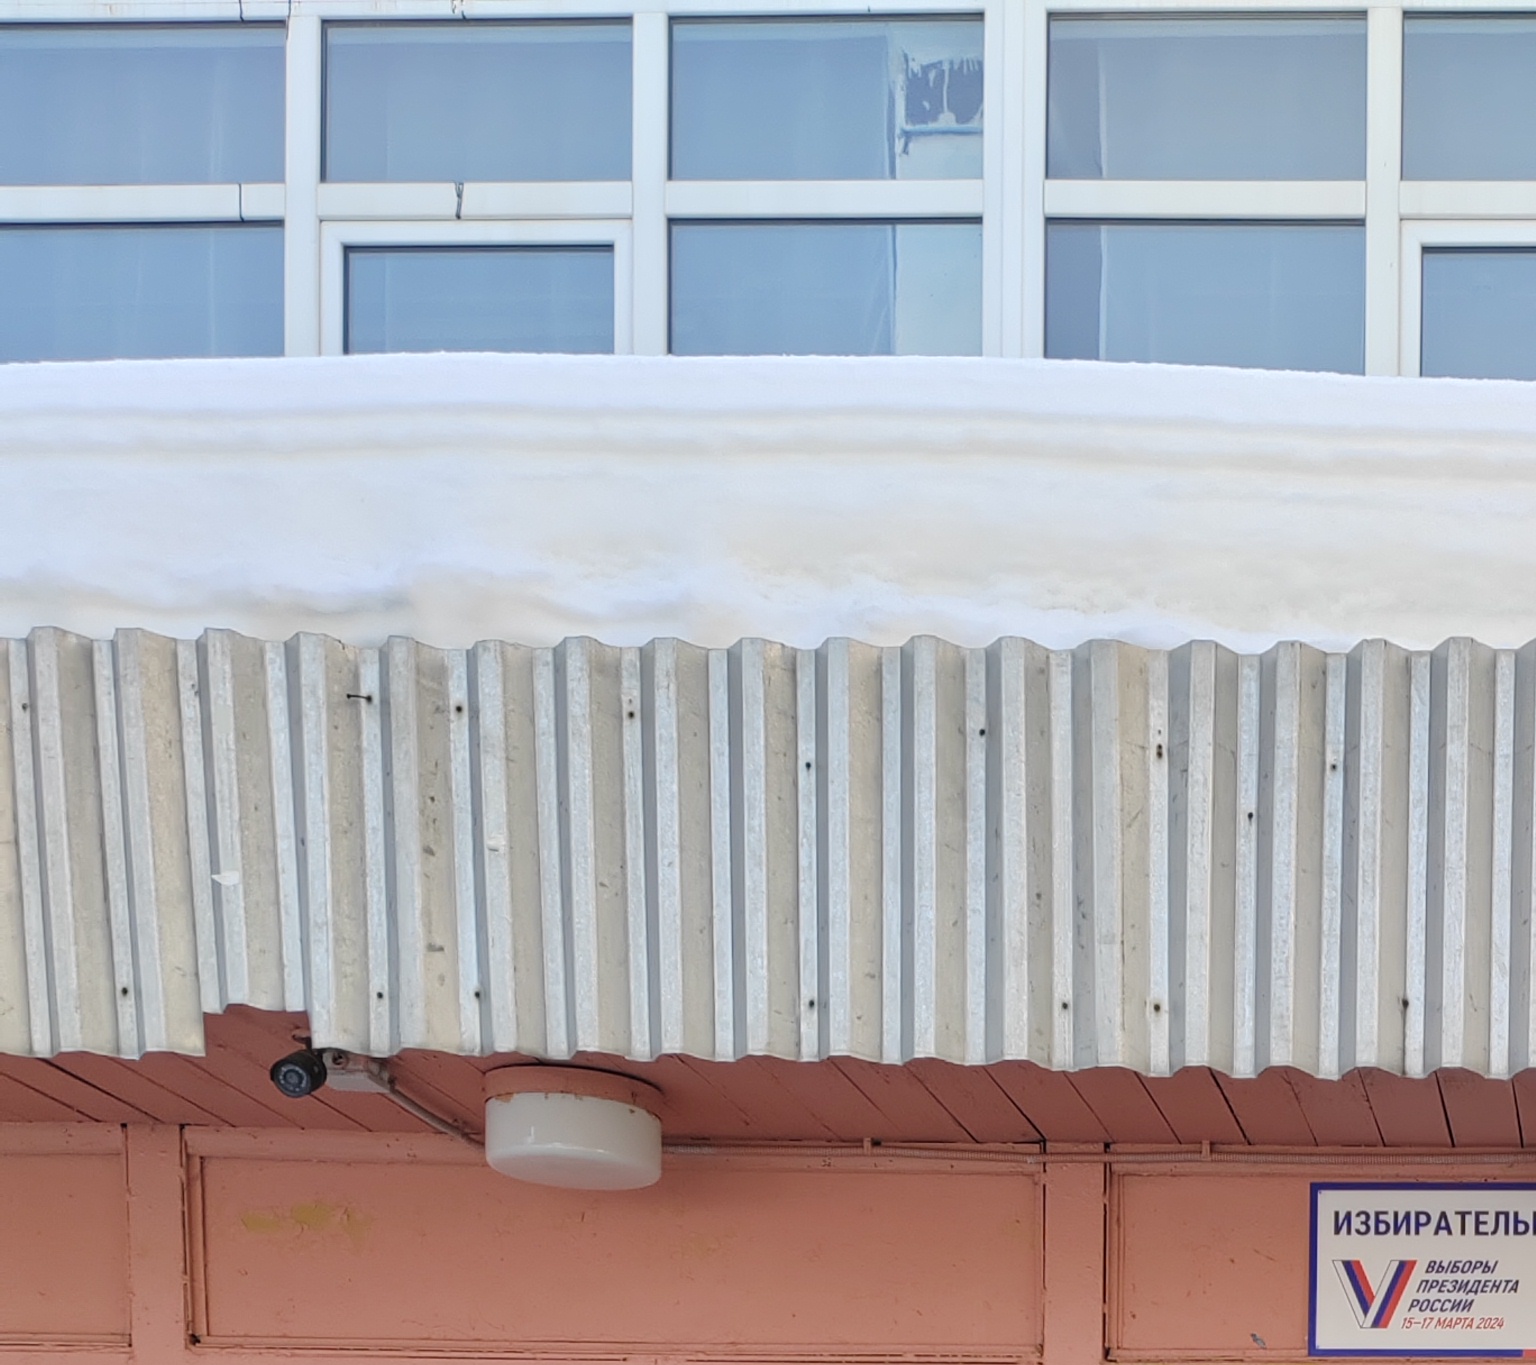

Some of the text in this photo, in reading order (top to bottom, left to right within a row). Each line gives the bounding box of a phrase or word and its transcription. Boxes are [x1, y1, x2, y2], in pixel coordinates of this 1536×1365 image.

[1425, 1260, 1498, 1275] ВЫБОРЫ
[1416, 1279, 1519, 1295] ПРЕЗИДЕНТА
[1408, 1299, 1474, 1313] РОССИИ
[1436, 1317, 1474, 1329] МАРТА
[1476, 1317, 1504, 1329] 2024
